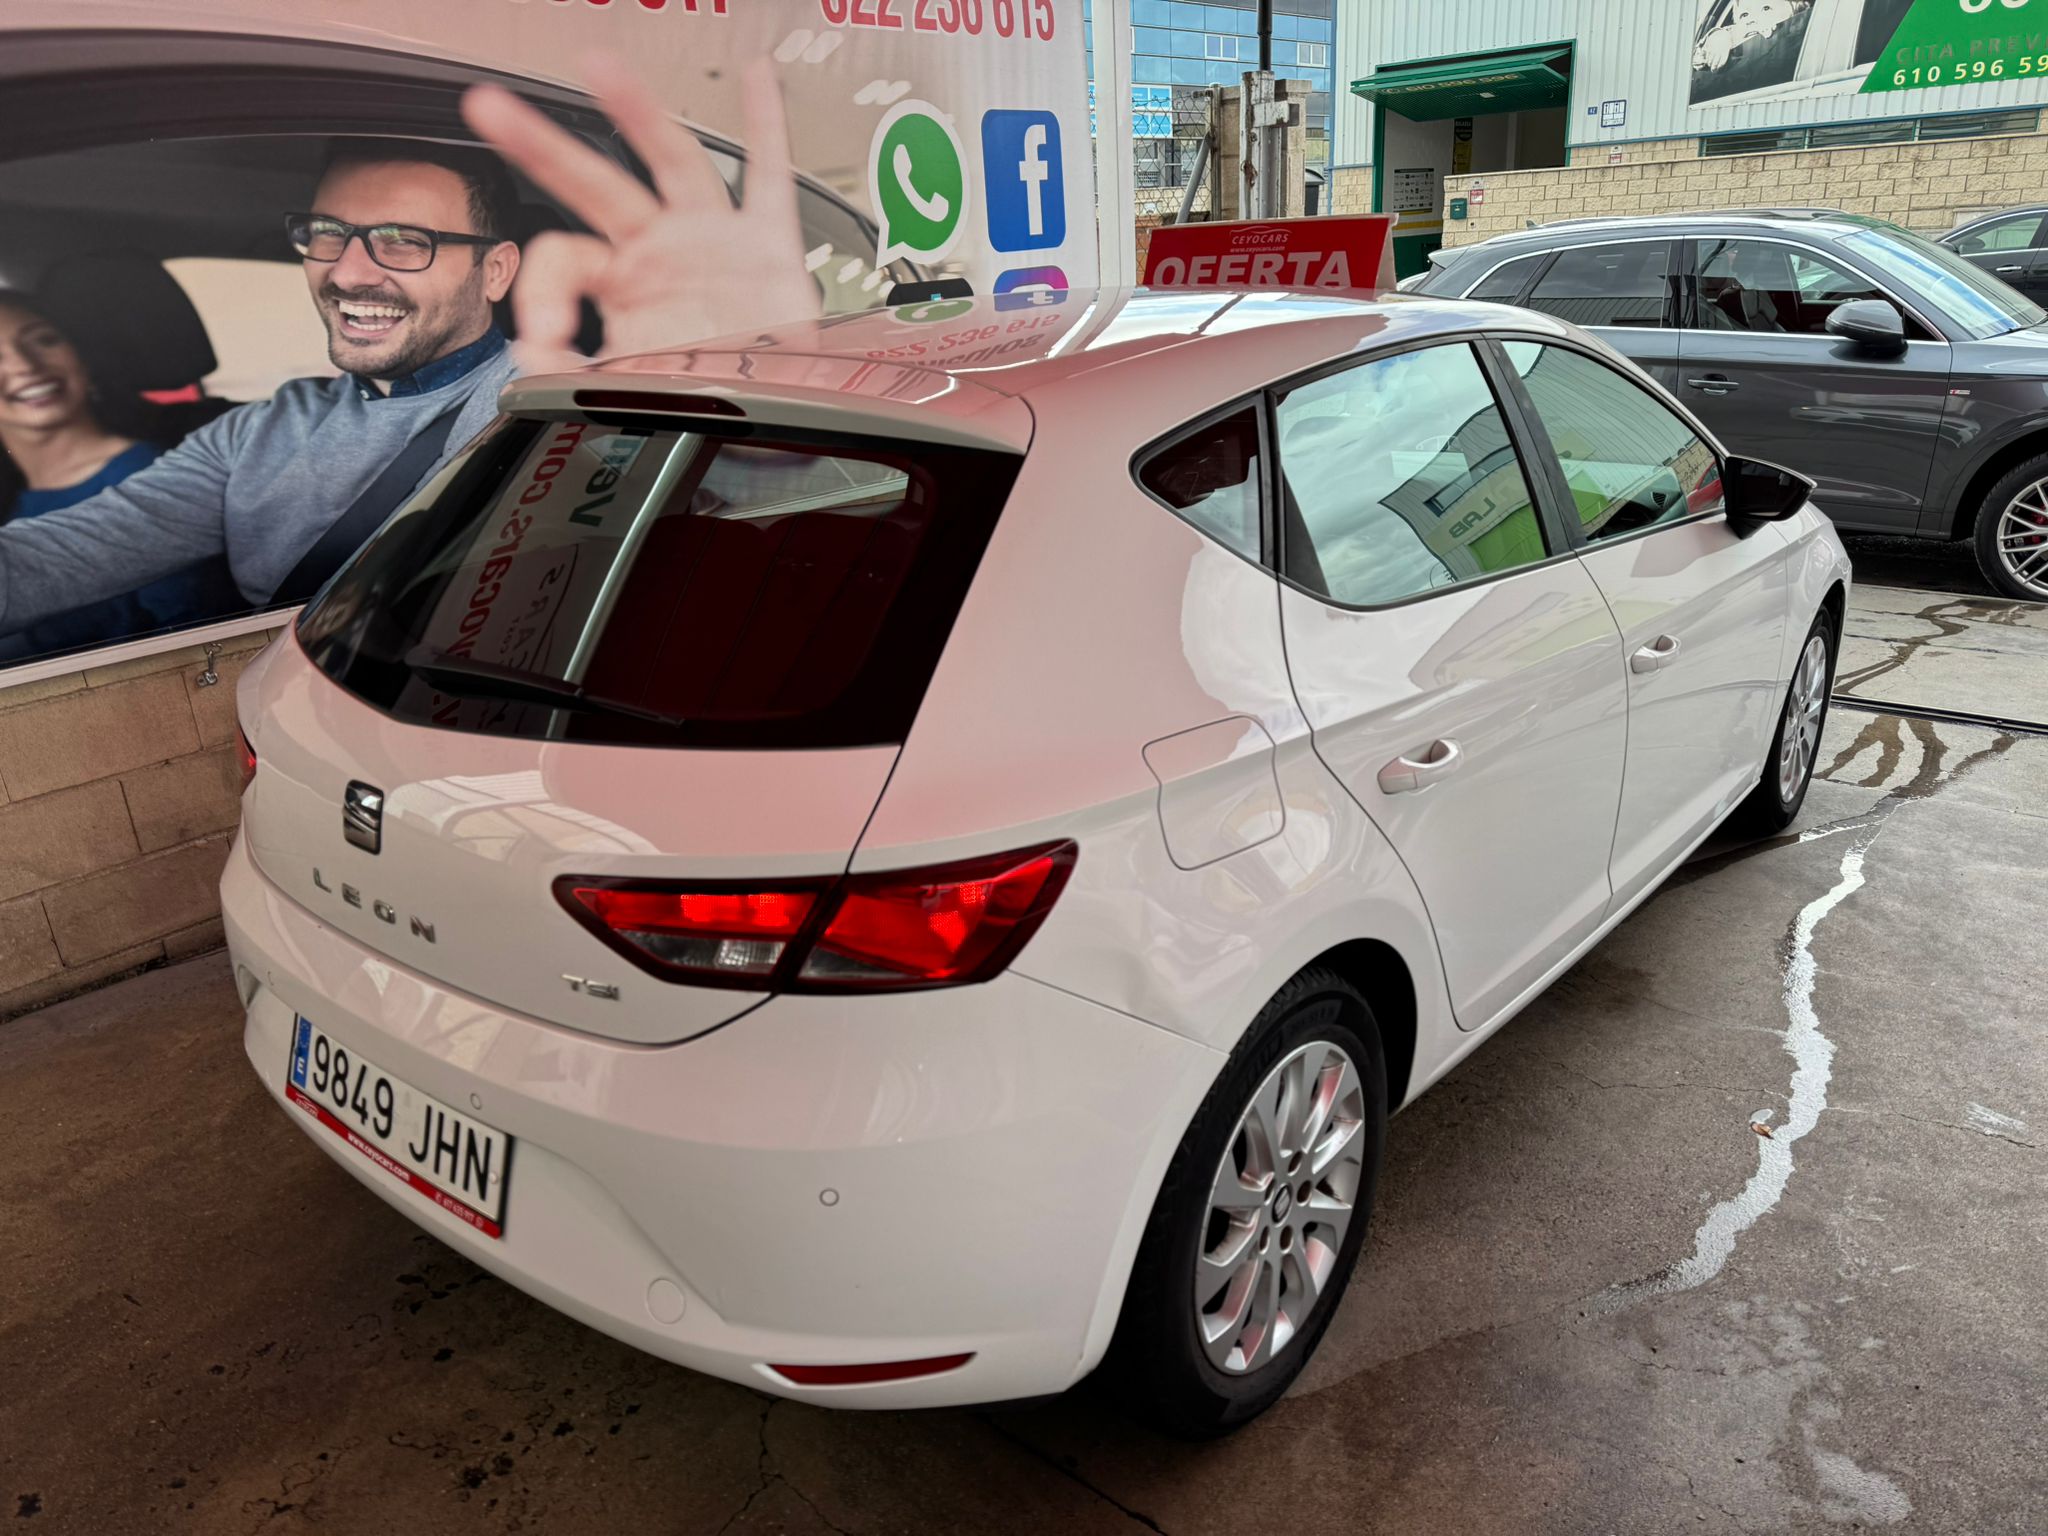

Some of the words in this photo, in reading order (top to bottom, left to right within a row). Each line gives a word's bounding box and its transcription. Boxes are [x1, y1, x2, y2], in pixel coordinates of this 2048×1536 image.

[1893, 66, 1941, 86] 610
[1954, 60, 2004, 80] 596
[1231, 233, 1289, 245] CEYOCARS
[1152, 250, 1352, 288] OFERTA
[313, 867, 437, 945] LEON
[561, 973, 620, 1001] TSI
[312, 1034, 395, 1140] 9849
[408, 1103, 492, 1202] JHN
